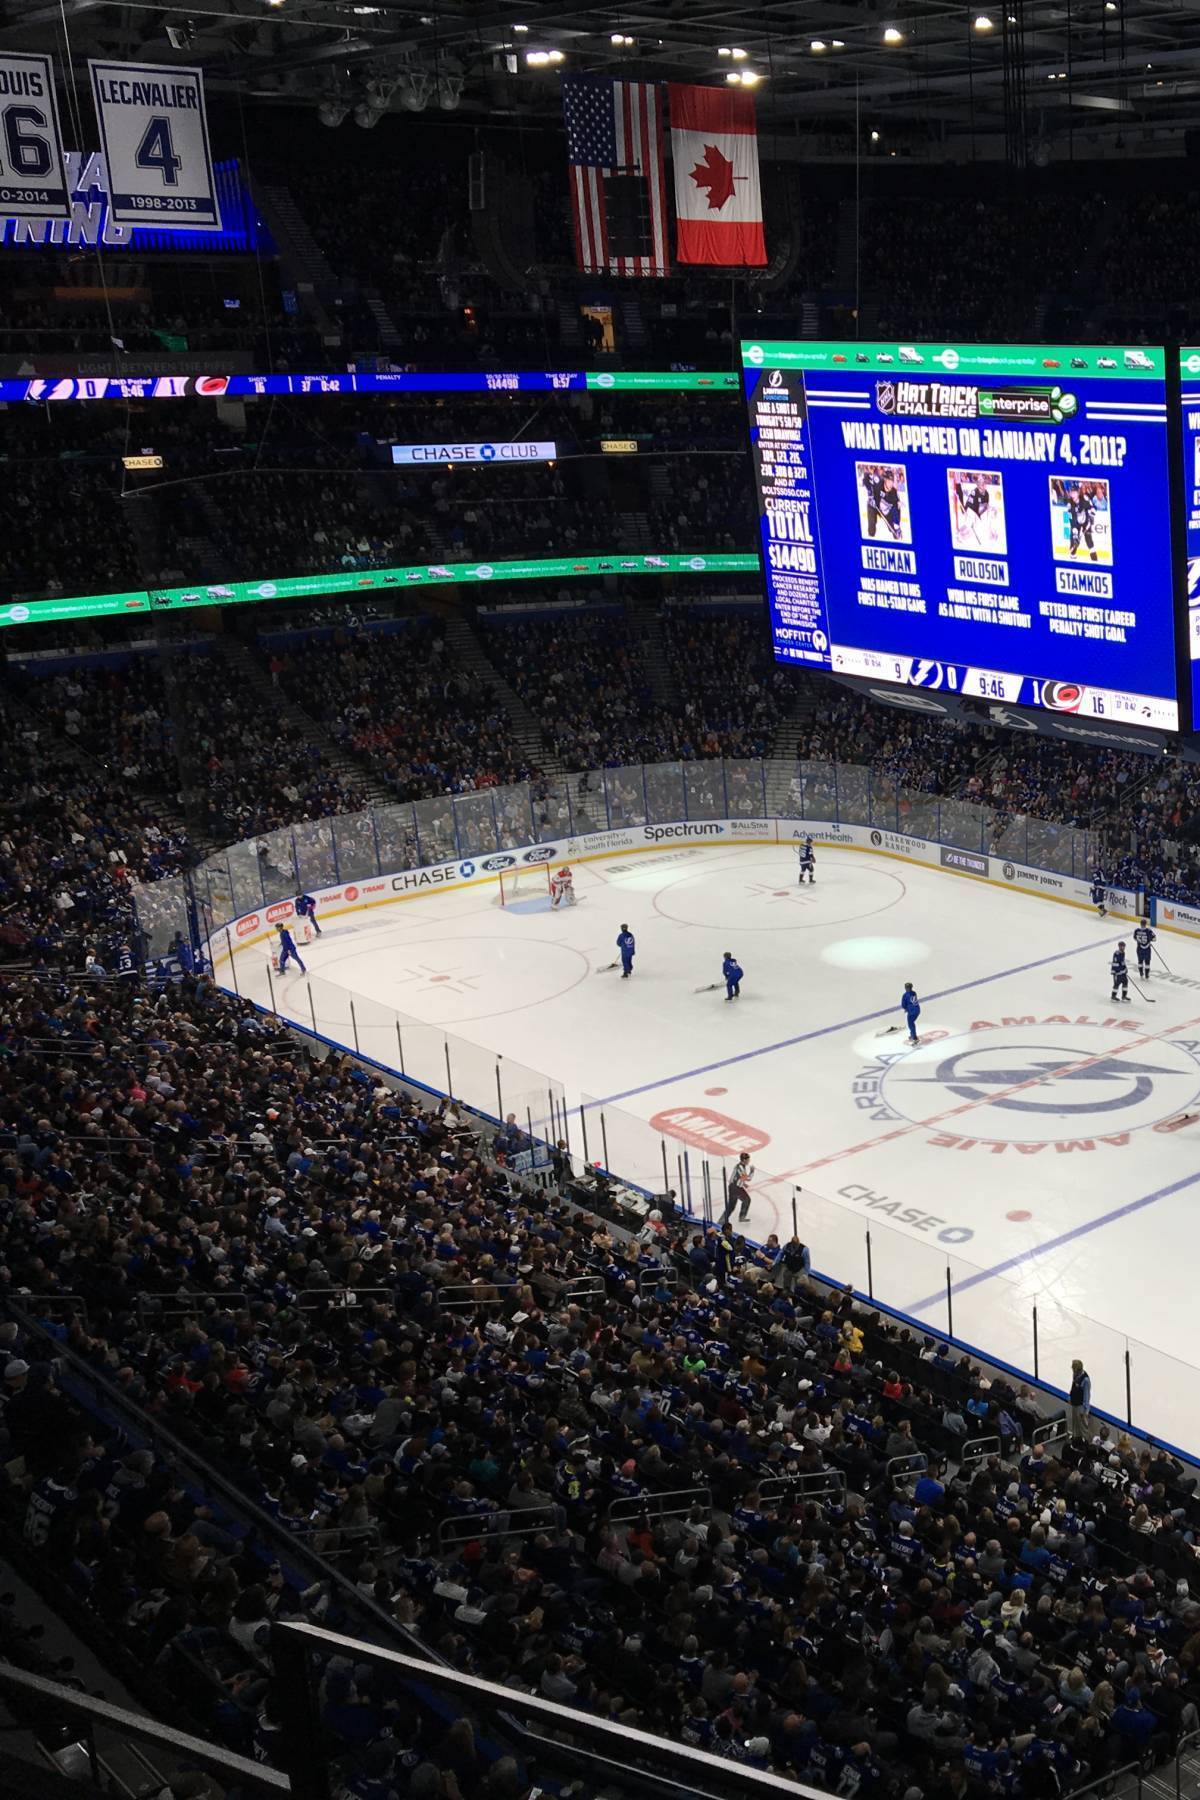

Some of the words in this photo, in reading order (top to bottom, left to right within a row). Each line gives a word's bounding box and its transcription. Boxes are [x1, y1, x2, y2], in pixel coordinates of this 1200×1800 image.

[99, 79, 198, 109] LECAVALIER
[0, 104, 53, 178] 6
[135, 115, 182, 186] 4
[130, 196, 197, 210] 1998-2013
[78, 362, 113, 375] LIGHT
[121, 361, 177, 374] BETWEEN
[86, 380, 96, 397] 0
[120, 385, 144, 398] 9:46
[127, 378, 152, 386] Period
[255, 382, 265, 394] 16
[487, 378, 518, 390] $14490
[897, 382, 928, 401] HAT
[930, 383, 978, 405] TRICK
[756, 401, 771, 414] TAKE
[775, 402, 790, 415] SHOT
[896, 401, 977, 418] CHALLENGE
[983, 394, 1049, 413] enterprise
[759, 427, 774, 440] CASH
[411, 445, 476, 461] CHASE
[501, 443, 538, 460] CLUB
[601, 441, 628, 451] CHASE
[840, 421, 881, 451] WHAT
[882, 423, 958, 455] HAPPENED
[958, 428, 982, 457] ON
[982, 428, 1057, 463] JANUARY
[1059, 433, 1078, 466] 4,
[1079, 435, 1127, 467] 2011?
[123, 457, 153, 468] CHASE
[774, 477, 788, 487] AND
[765, 498, 810, 514] CURRENT
[766, 510, 814, 543] TOTAL
[768, 543, 817, 574] $14490
[866, 549, 912, 573] HEDMAN
[959, 563, 1005, 582] ROLOSON
[772, 581, 793, 590] CANCER
[792, 583, 820, 594] RESEARCH
[860, 576, 876, 591] WAS
[1059, 572, 1110, 594] STAMKOS
[775, 595, 792, 604] LOCAL
[788, 590, 809, 600] DOZENS
[857, 591, 876, 606] FIRST
[876, 593, 907, 611] ALL-STAR
[906, 597, 927, 614] GAME
[946, 587, 965, 603] WON
[964, 589, 978, 606] HIS
[977, 591, 998, 608] FIRST
[998, 594, 1020, 612] GAME
[938, 602, 949, 617] AS
[954, 604, 972, 620] BOLT
[971, 606, 991, 623] WITH
[997, 610, 1031, 629] SHUTOUT
[1039, 600, 1068, 618] NETTED
[1067, 604, 1082, 620] HIS
[1081, 606, 1104, 623] FIRST
[1104, 609, 1136, 627] CAREER
[775, 627, 812, 643] MOFFITT
[1049, 617, 1083, 637] PENALTY
[1083, 622, 1104, 640] SHOT
[1104, 625, 1127, 643] GOAL
[894, 663, 901, 679] 9
[946, 665, 957, 690] 0
[979, 677, 1005, 698] 9:46
[1032, 680, 1040, 705] 1
[1092, 696, 1105, 715] 16
[643, 823, 721, 842] Spectrum
[792, 828, 854, 843] AdventHealth
[884, 833, 927, 850] LAKEWOOD
[607, 838, 633, 849] Florida
[884, 841, 911, 854] RANCH
[486, 858, 512, 870] Ford
[528, 849, 553, 862] Ford
[391, 866, 457, 892] CHASE
[1017, 869, 1040, 883] JIMMY
[1040, 876, 1064, 888] JOHN'S
[362, 883, 386, 895] TRANE
[1109, 891, 1128, 908] Rock
[969, 1014, 1144, 1033] AMALIE
[854, 1052, 904, 1123] ARENA
[660, 1111, 762, 1151] AMALIE
[926, 1132, 1131, 1155] AMALIE
[837, 1183, 946, 1233] CHASE
